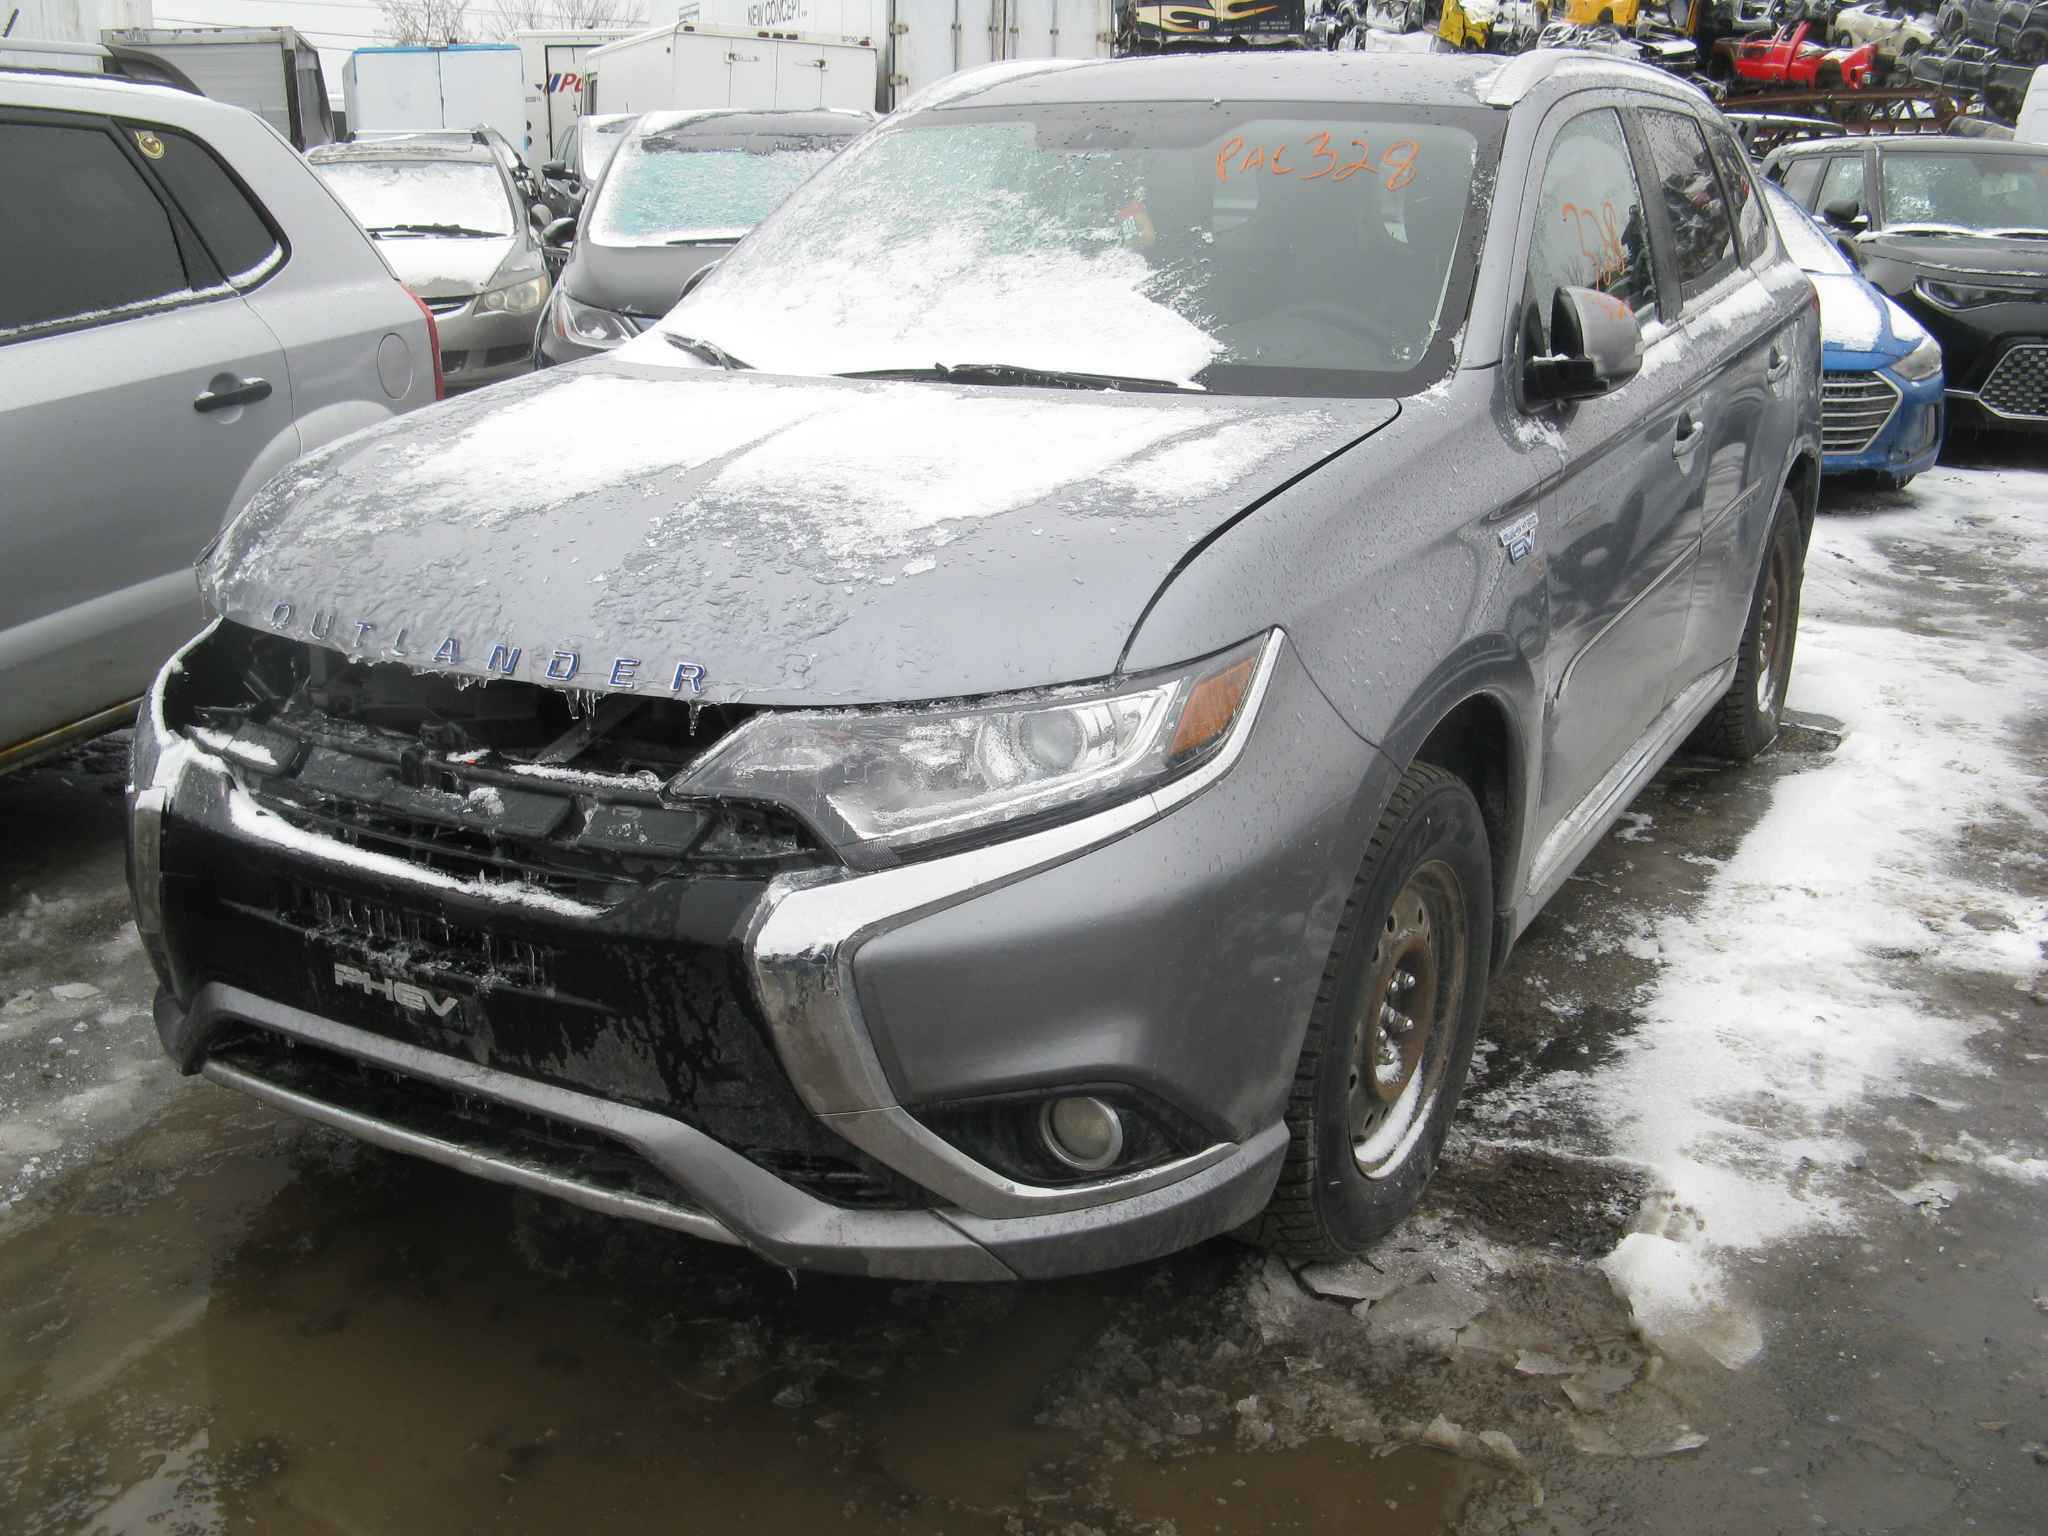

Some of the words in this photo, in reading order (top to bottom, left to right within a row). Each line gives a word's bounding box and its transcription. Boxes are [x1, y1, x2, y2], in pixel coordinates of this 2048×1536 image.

[747, 3, 764, 27] NEW
[1297, 130, 1420, 192] 328
[268, 602, 707, 693] OUTLANDER
[333, 961, 459, 1017] PHEV
